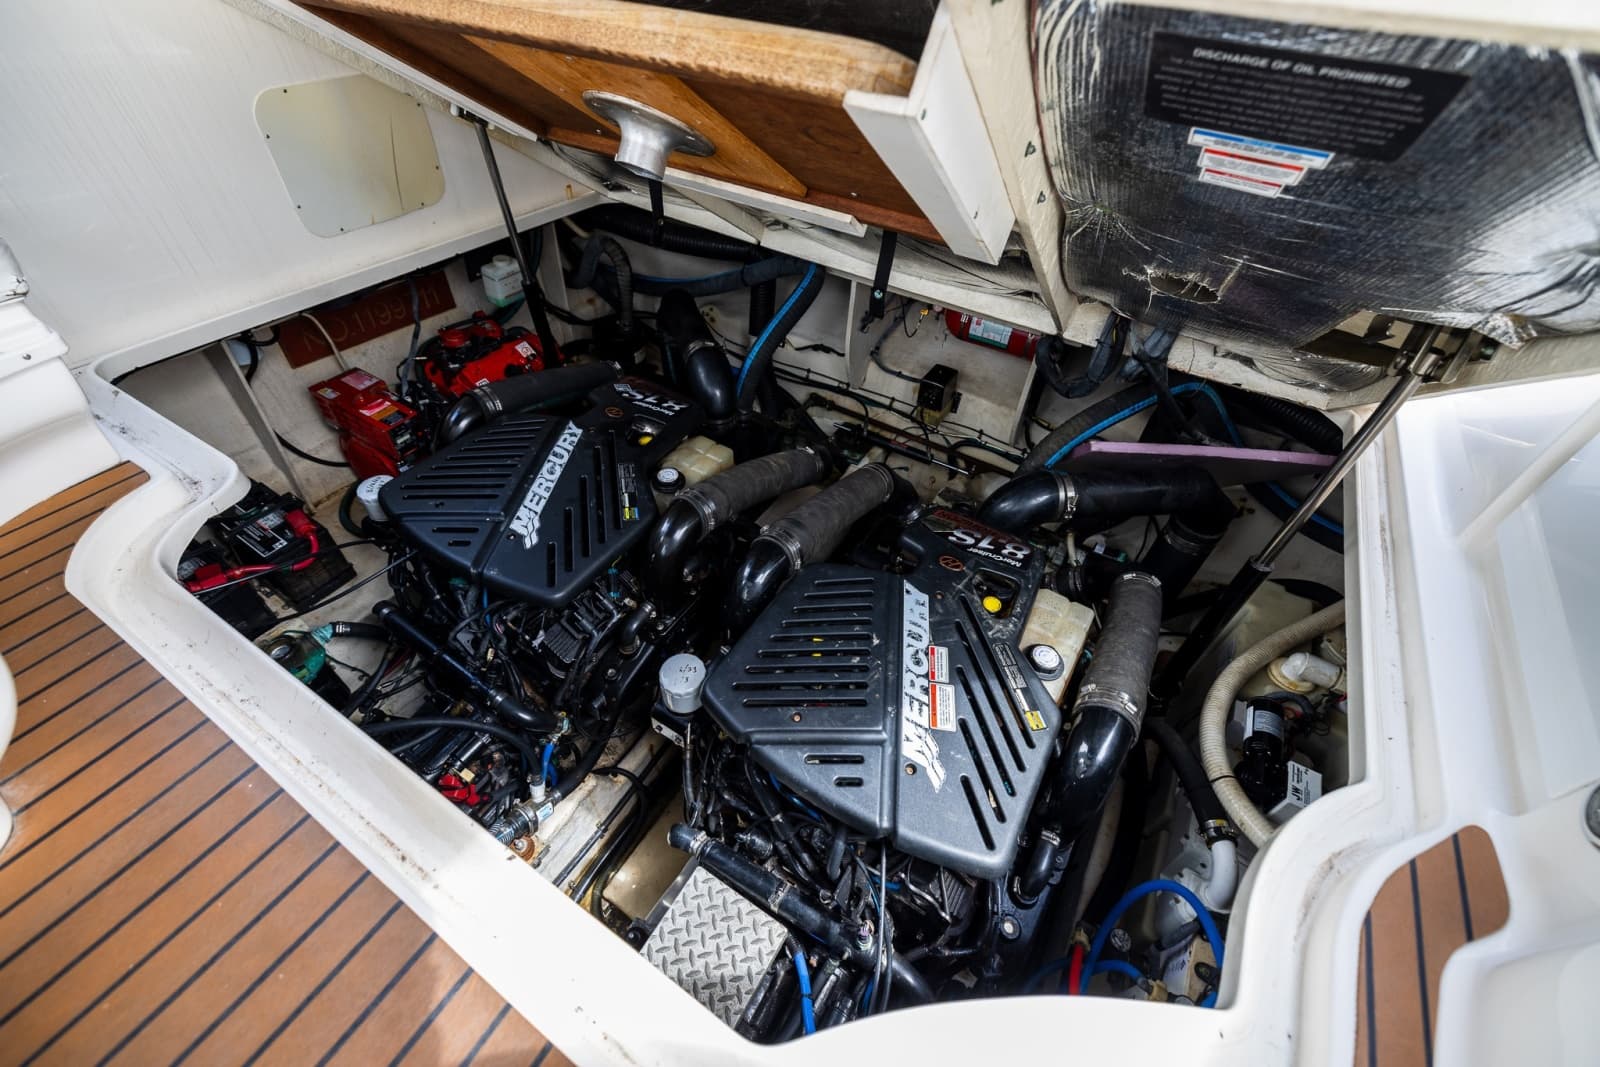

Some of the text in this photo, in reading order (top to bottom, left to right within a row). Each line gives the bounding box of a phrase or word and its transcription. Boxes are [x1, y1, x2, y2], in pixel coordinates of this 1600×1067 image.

[1193, 48, 1411, 88] DISCHARGE OF OIL PROHIBITED
[303, 286, 440, 353] NO.119911
[509, 420, 583, 537] MERCURY
[948, 528, 1031, 560] 8.1S
